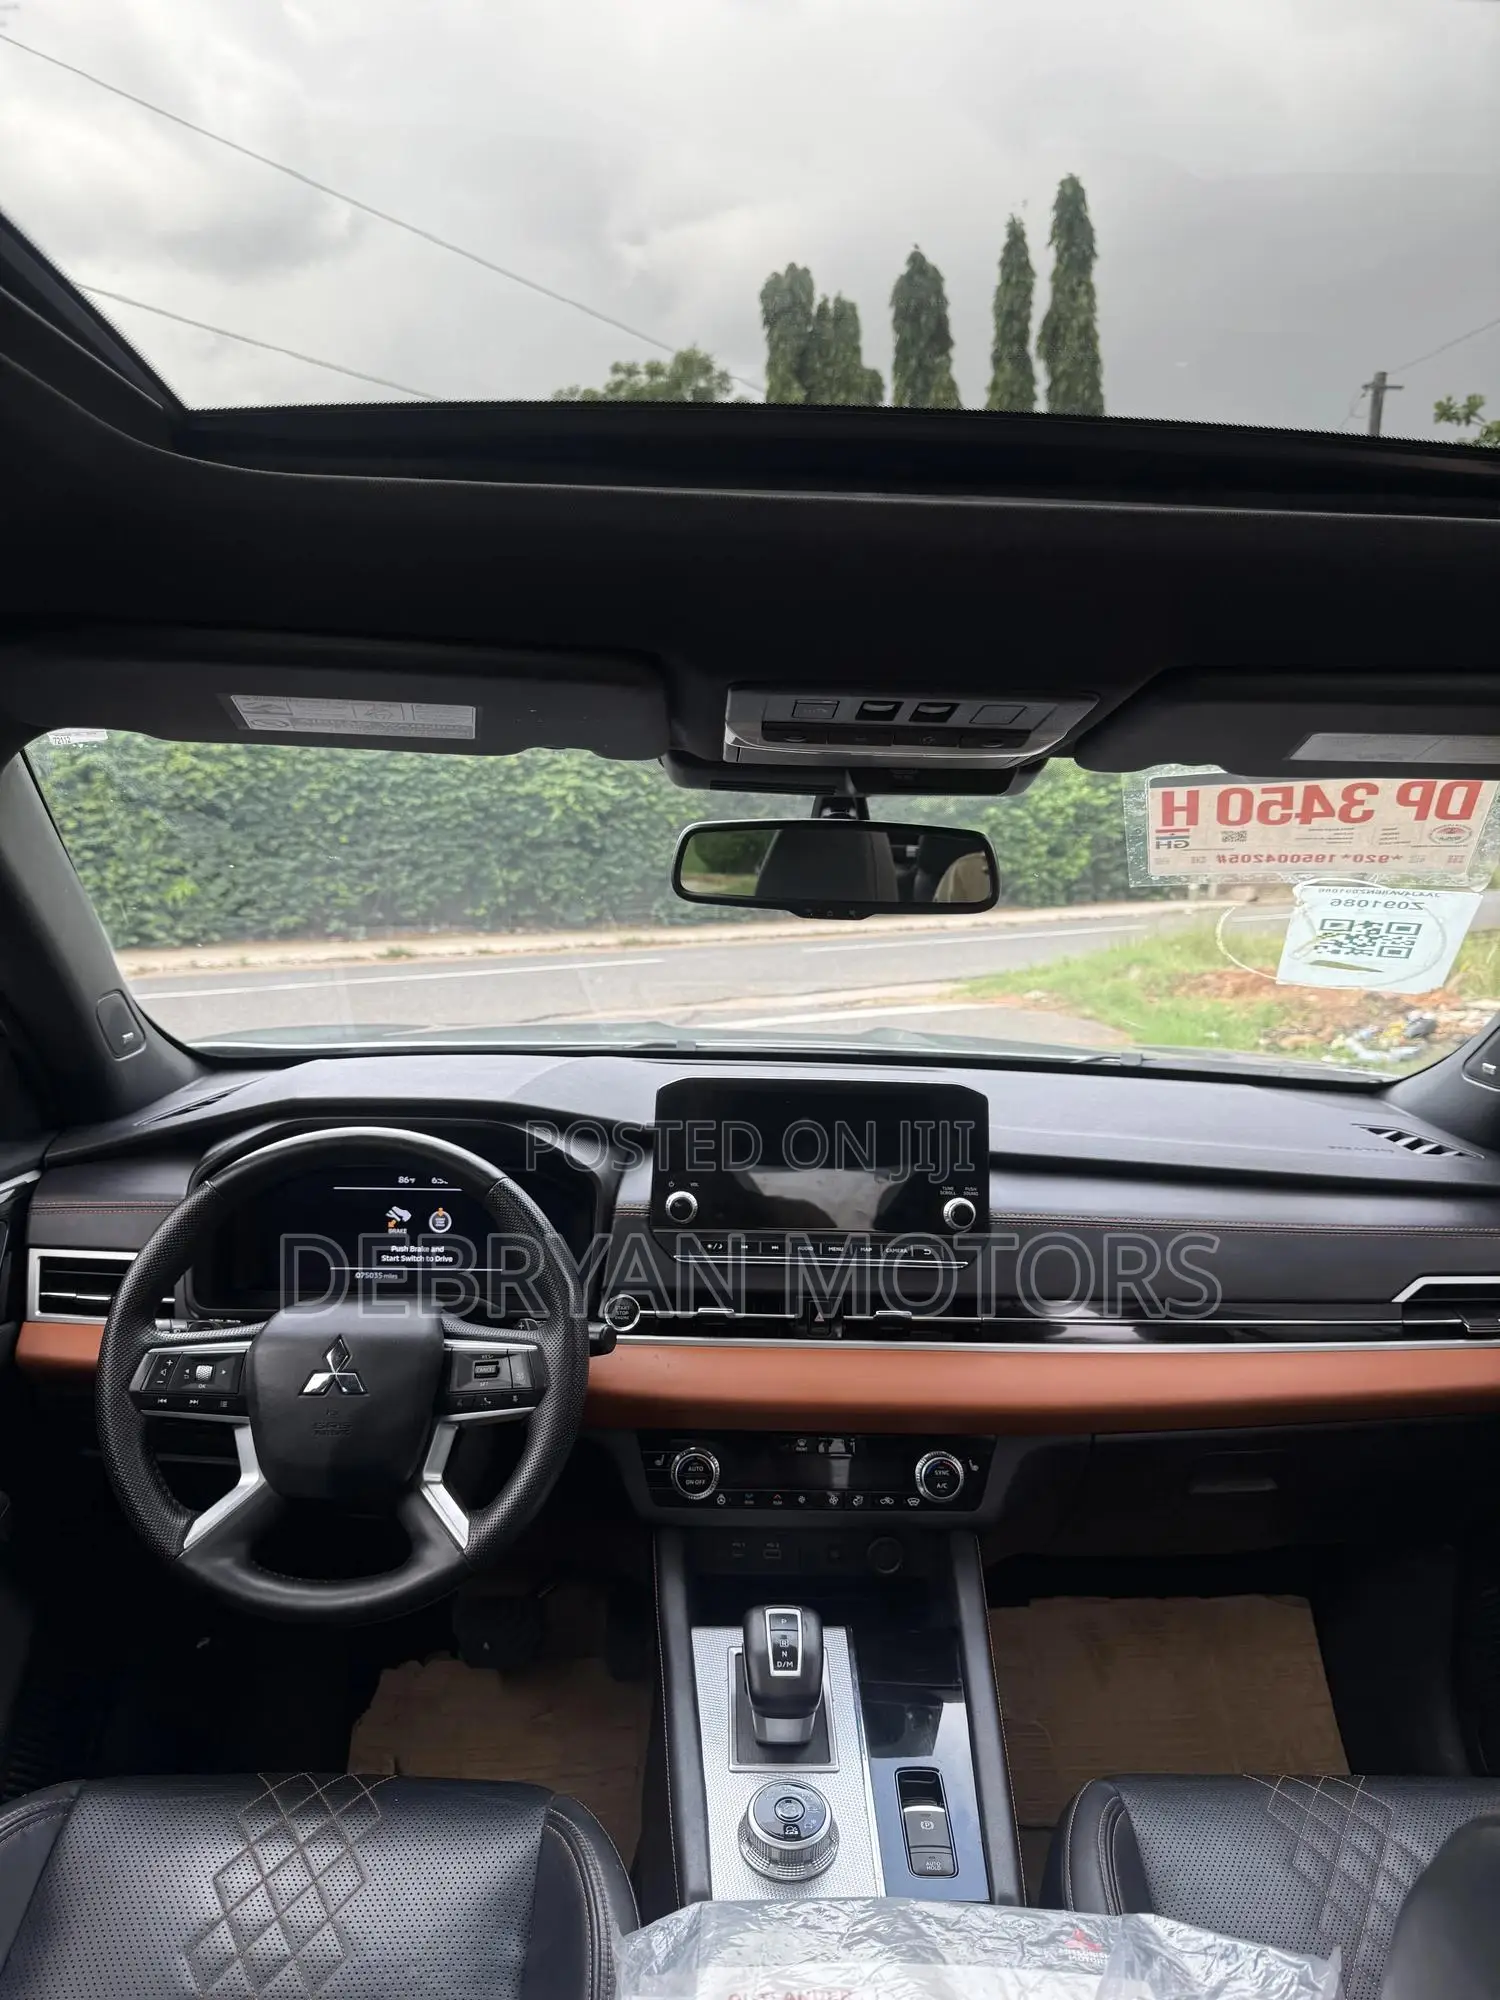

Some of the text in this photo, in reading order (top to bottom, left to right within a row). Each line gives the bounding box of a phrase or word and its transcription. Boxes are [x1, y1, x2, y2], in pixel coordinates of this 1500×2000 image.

[390, 1245, 444, 1253] Push Brake and
